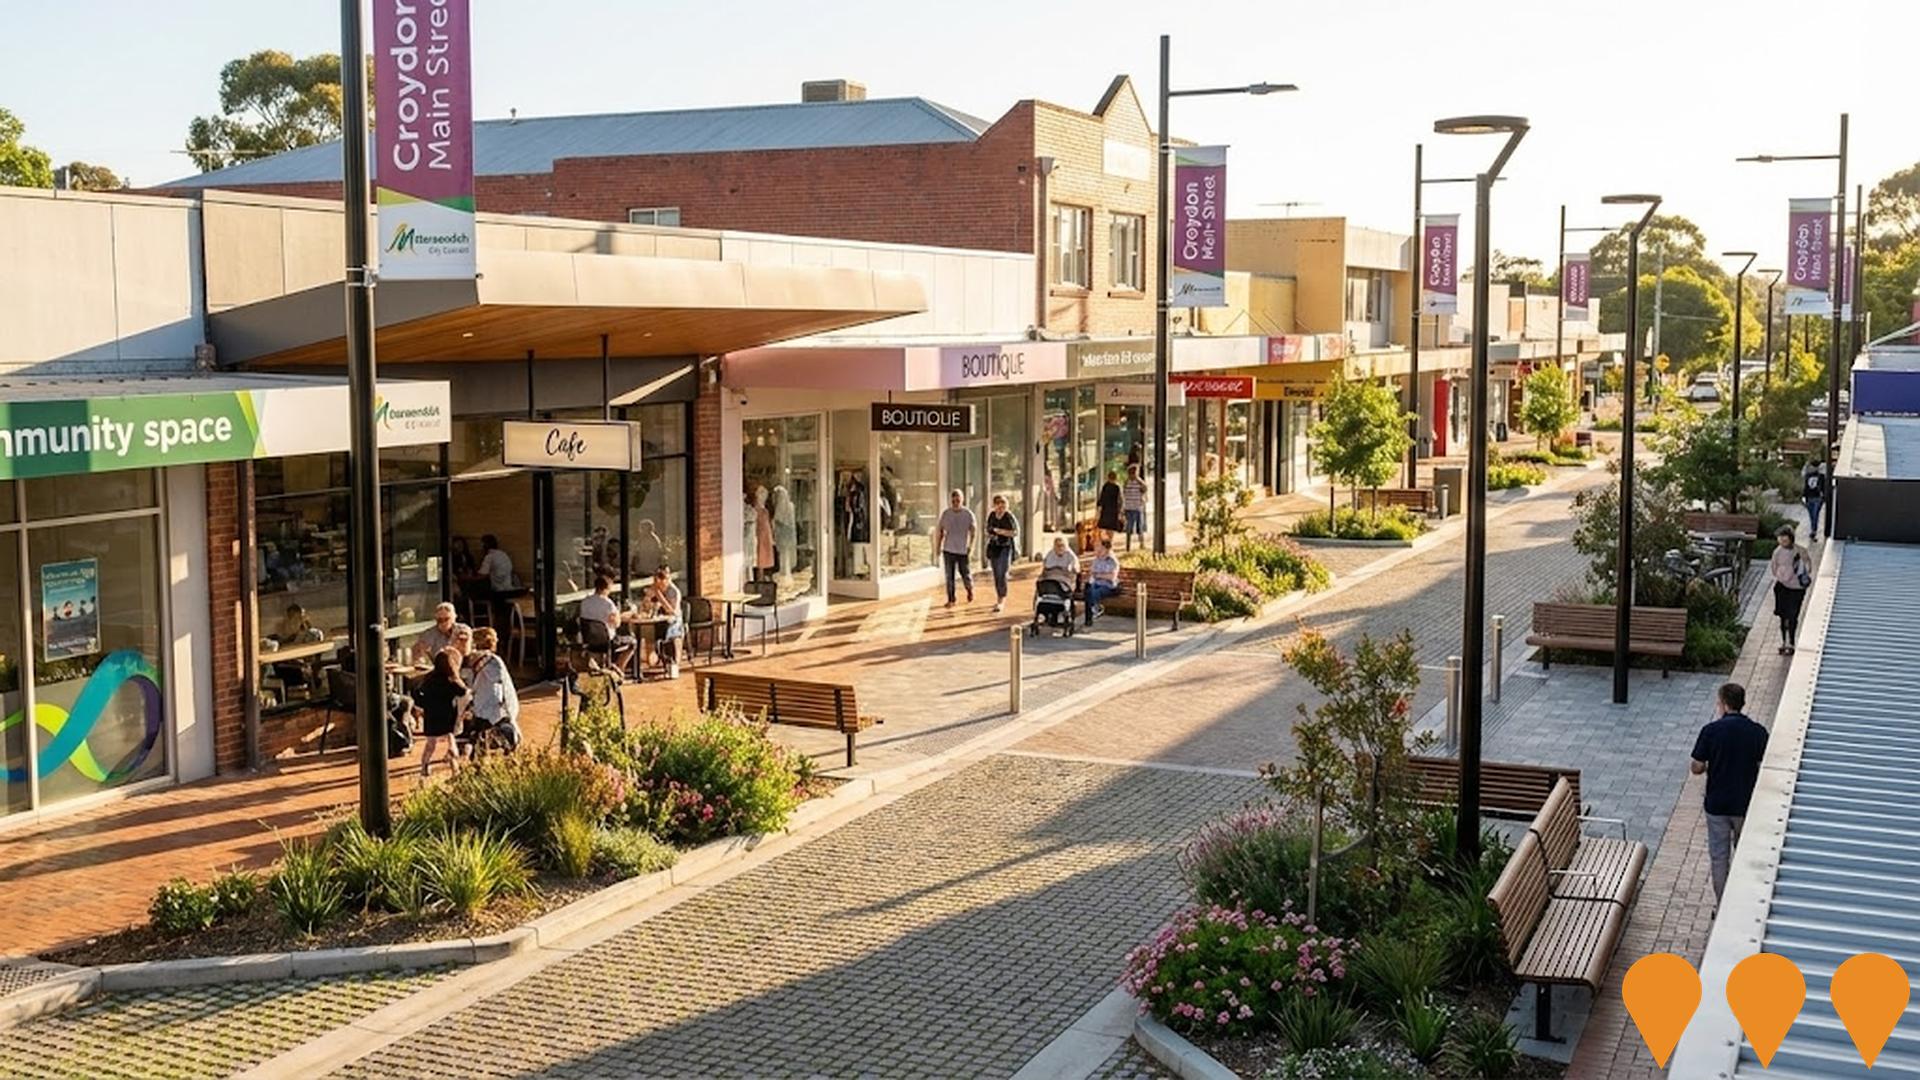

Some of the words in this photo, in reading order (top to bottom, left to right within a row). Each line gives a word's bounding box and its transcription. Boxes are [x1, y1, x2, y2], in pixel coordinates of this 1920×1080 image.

[426, 88, 452, 170] Main
[961, 352, 1025, 379] BOUTIQUE
[143, 415, 233, 453] space
[545, 428, 587, 461] Cafe
